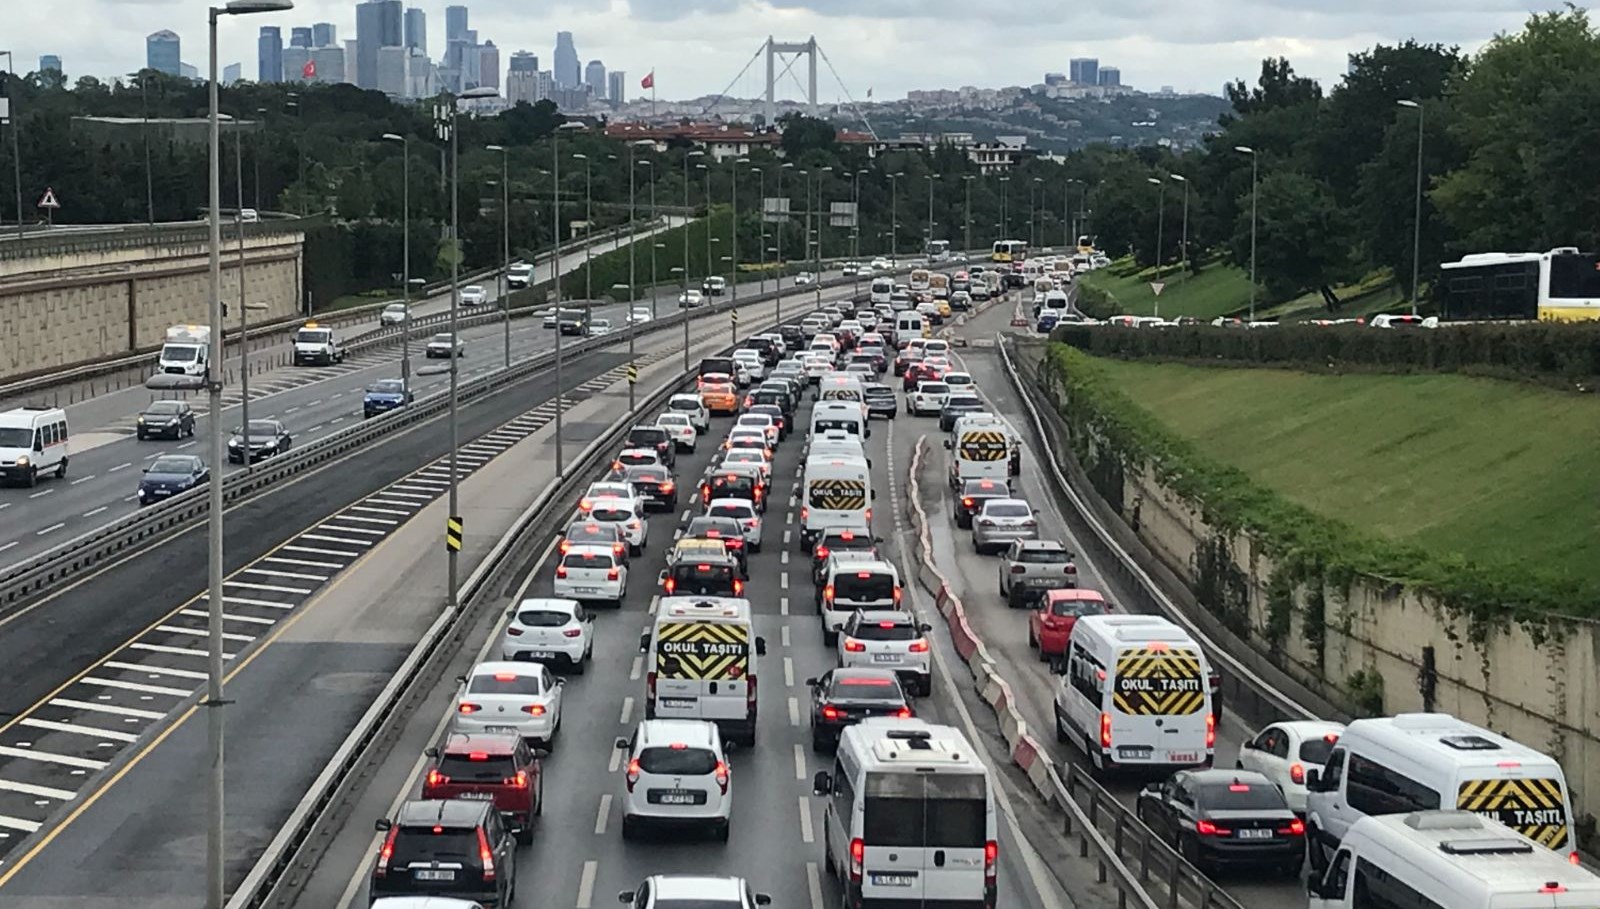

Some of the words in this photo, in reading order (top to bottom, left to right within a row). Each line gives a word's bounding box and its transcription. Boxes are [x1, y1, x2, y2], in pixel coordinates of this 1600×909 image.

[812, 488, 834, 497] OKUL
[663, 642, 699, 653] OKUL
[703, 643, 742, 656] TAŞITI
[1121, 678, 1154, 690] OKUL
[1160, 679, 1199, 692] TAŞITI
[1514, 809, 1561, 826] TAŞITI
